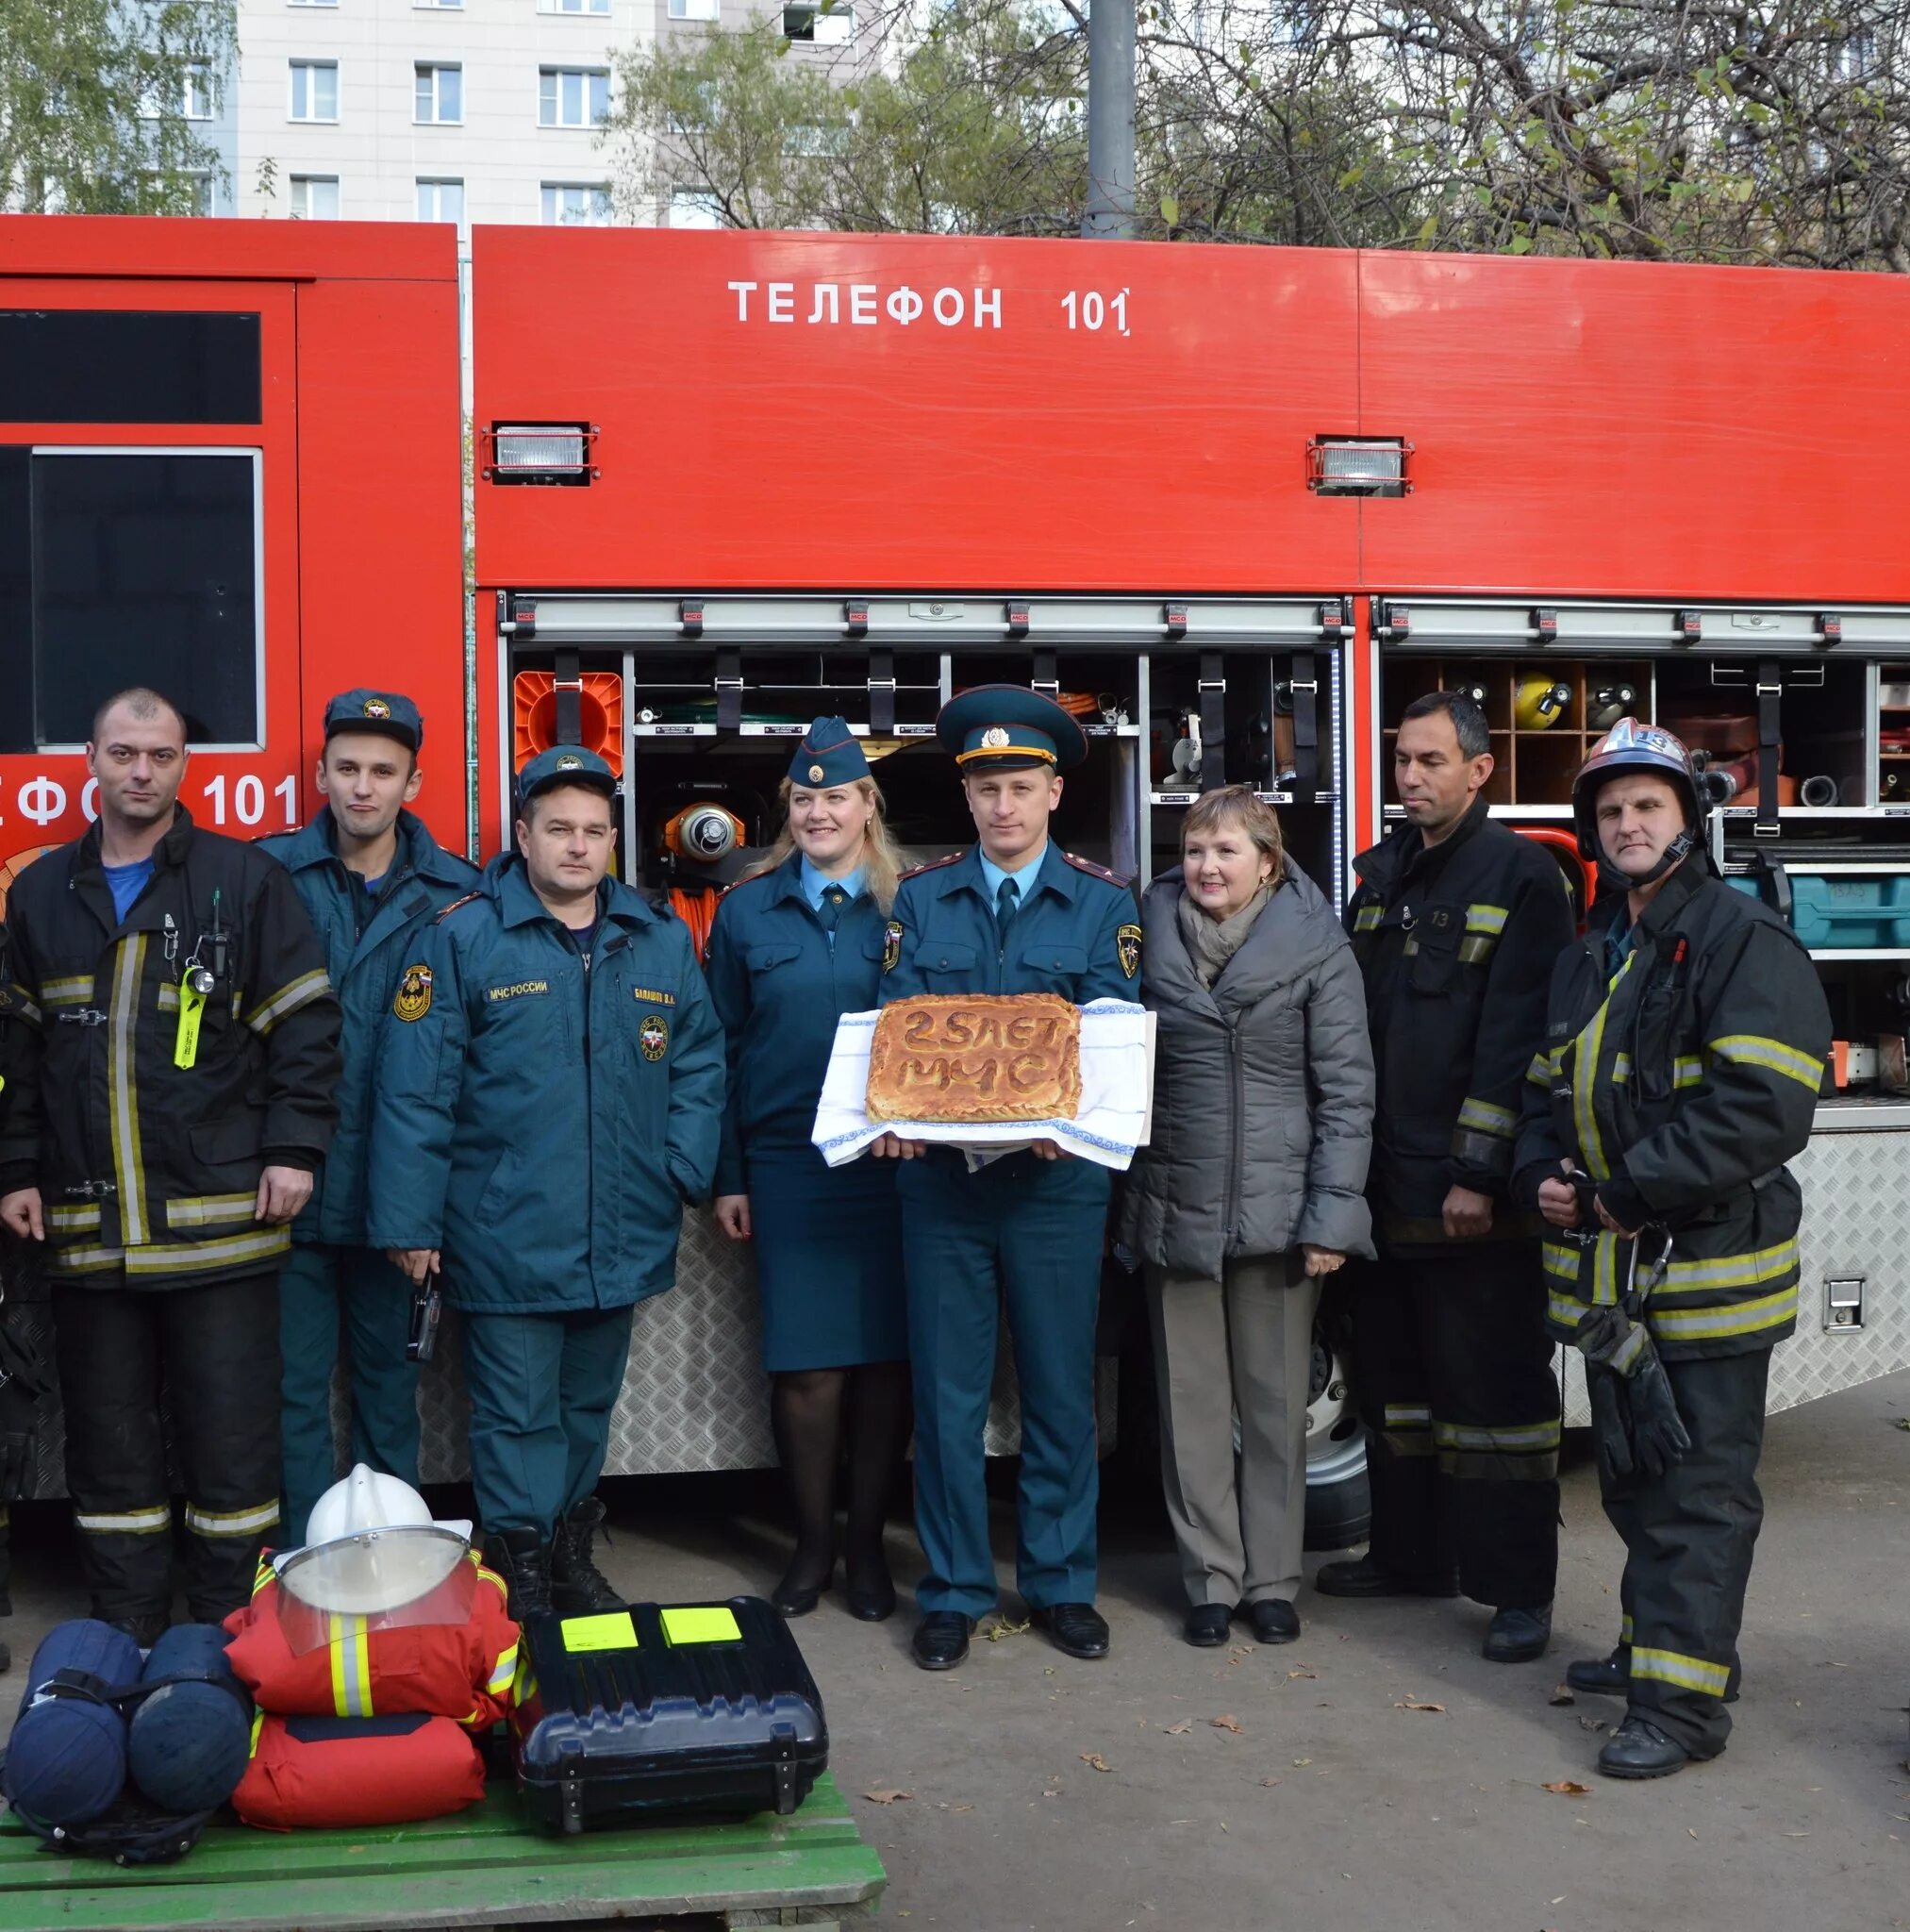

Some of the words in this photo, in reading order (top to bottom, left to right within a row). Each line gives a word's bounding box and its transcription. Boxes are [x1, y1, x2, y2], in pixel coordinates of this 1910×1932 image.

[727, 280, 1003, 329] ТЕЛЕФОН
[1060, 290, 1128, 335] 101
[204, 774, 296, 825] 101
[1430, 909, 1450, 927] 13
[490, 985, 510, 1000] МЧС
[510, 981, 548, 997] РОССИИ
